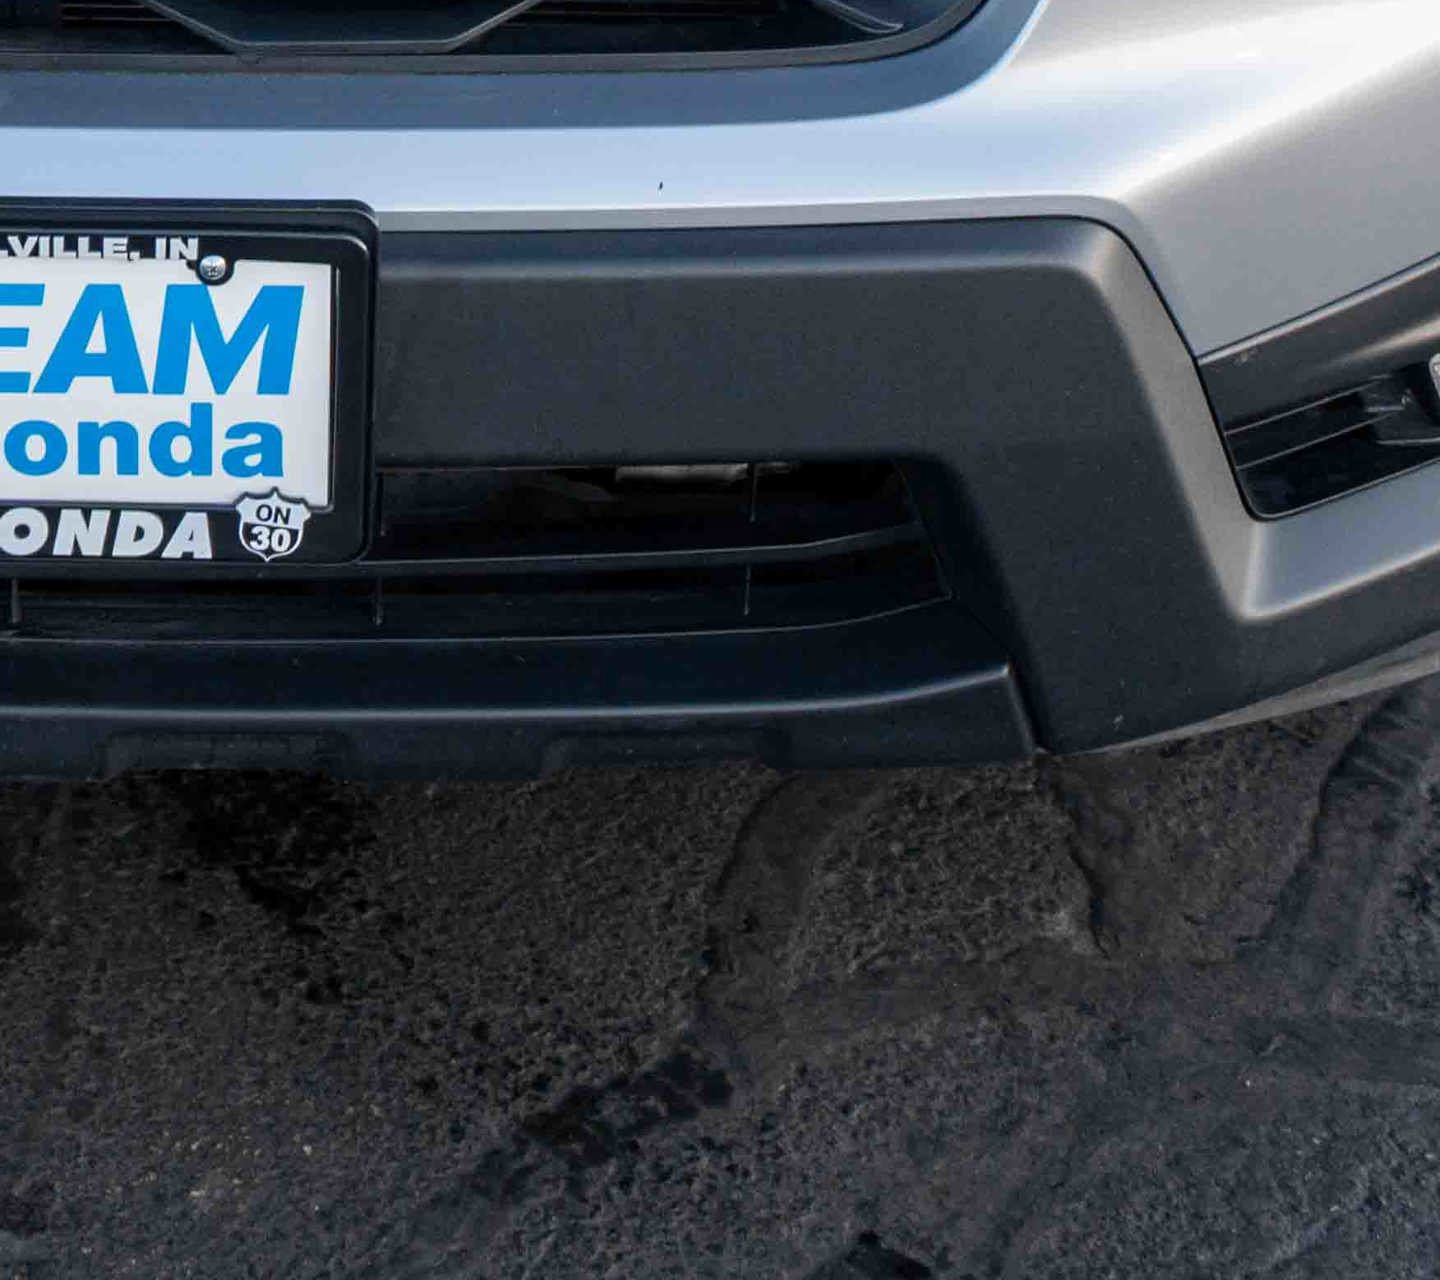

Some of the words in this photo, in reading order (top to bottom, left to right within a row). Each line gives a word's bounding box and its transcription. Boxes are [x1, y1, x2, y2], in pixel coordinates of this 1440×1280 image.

[155, 237, 199, 260] IN
[256, 505, 291, 524] ON
[250, 525, 291, 552] 30
